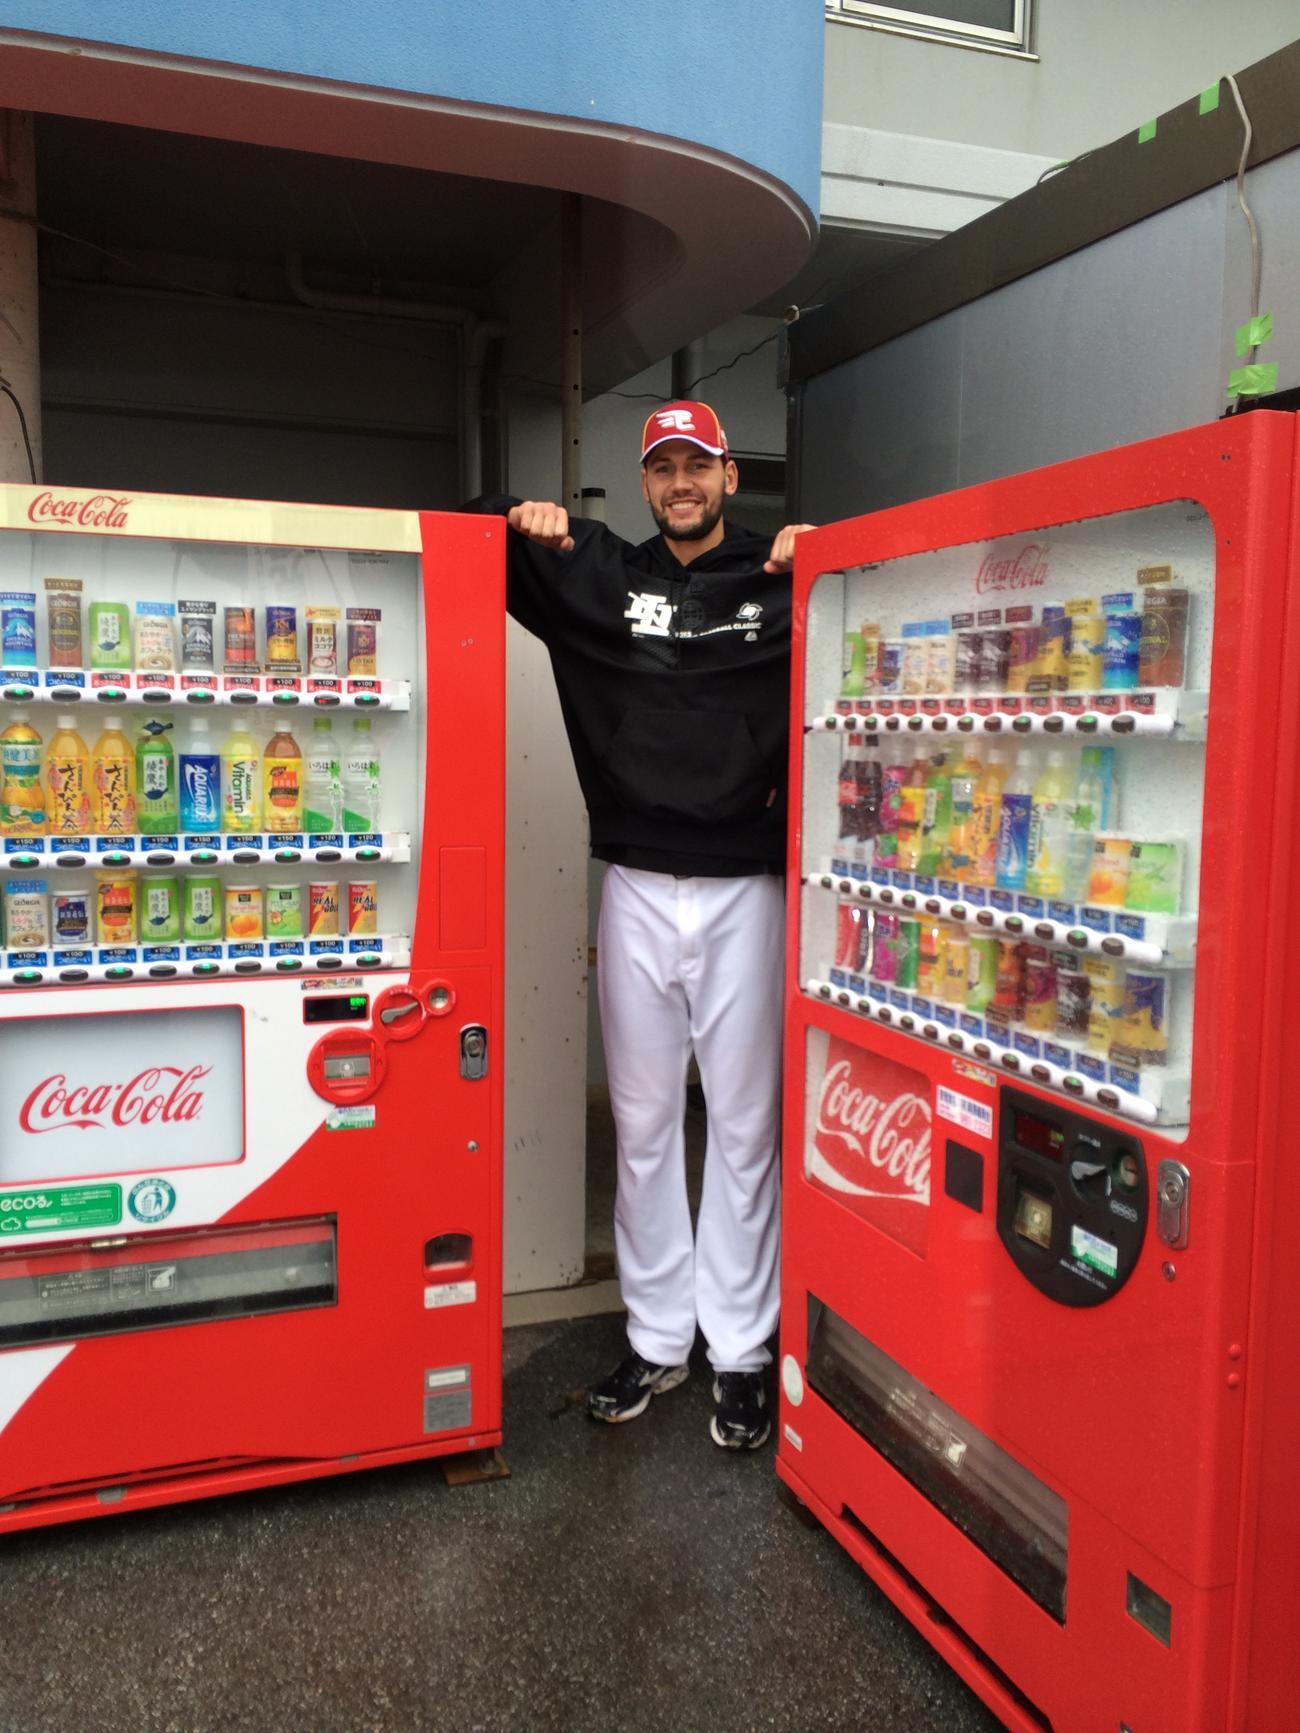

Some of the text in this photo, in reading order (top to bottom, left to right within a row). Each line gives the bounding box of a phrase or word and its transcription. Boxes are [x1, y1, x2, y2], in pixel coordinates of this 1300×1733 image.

[27, 491, 132, 528] Coca-Cola
[976, 544, 1049, 595] Coca-Cola
[232, 761, 245, 814] Vitamin
[20, 1064, 213, 1135] Coca-Cola
